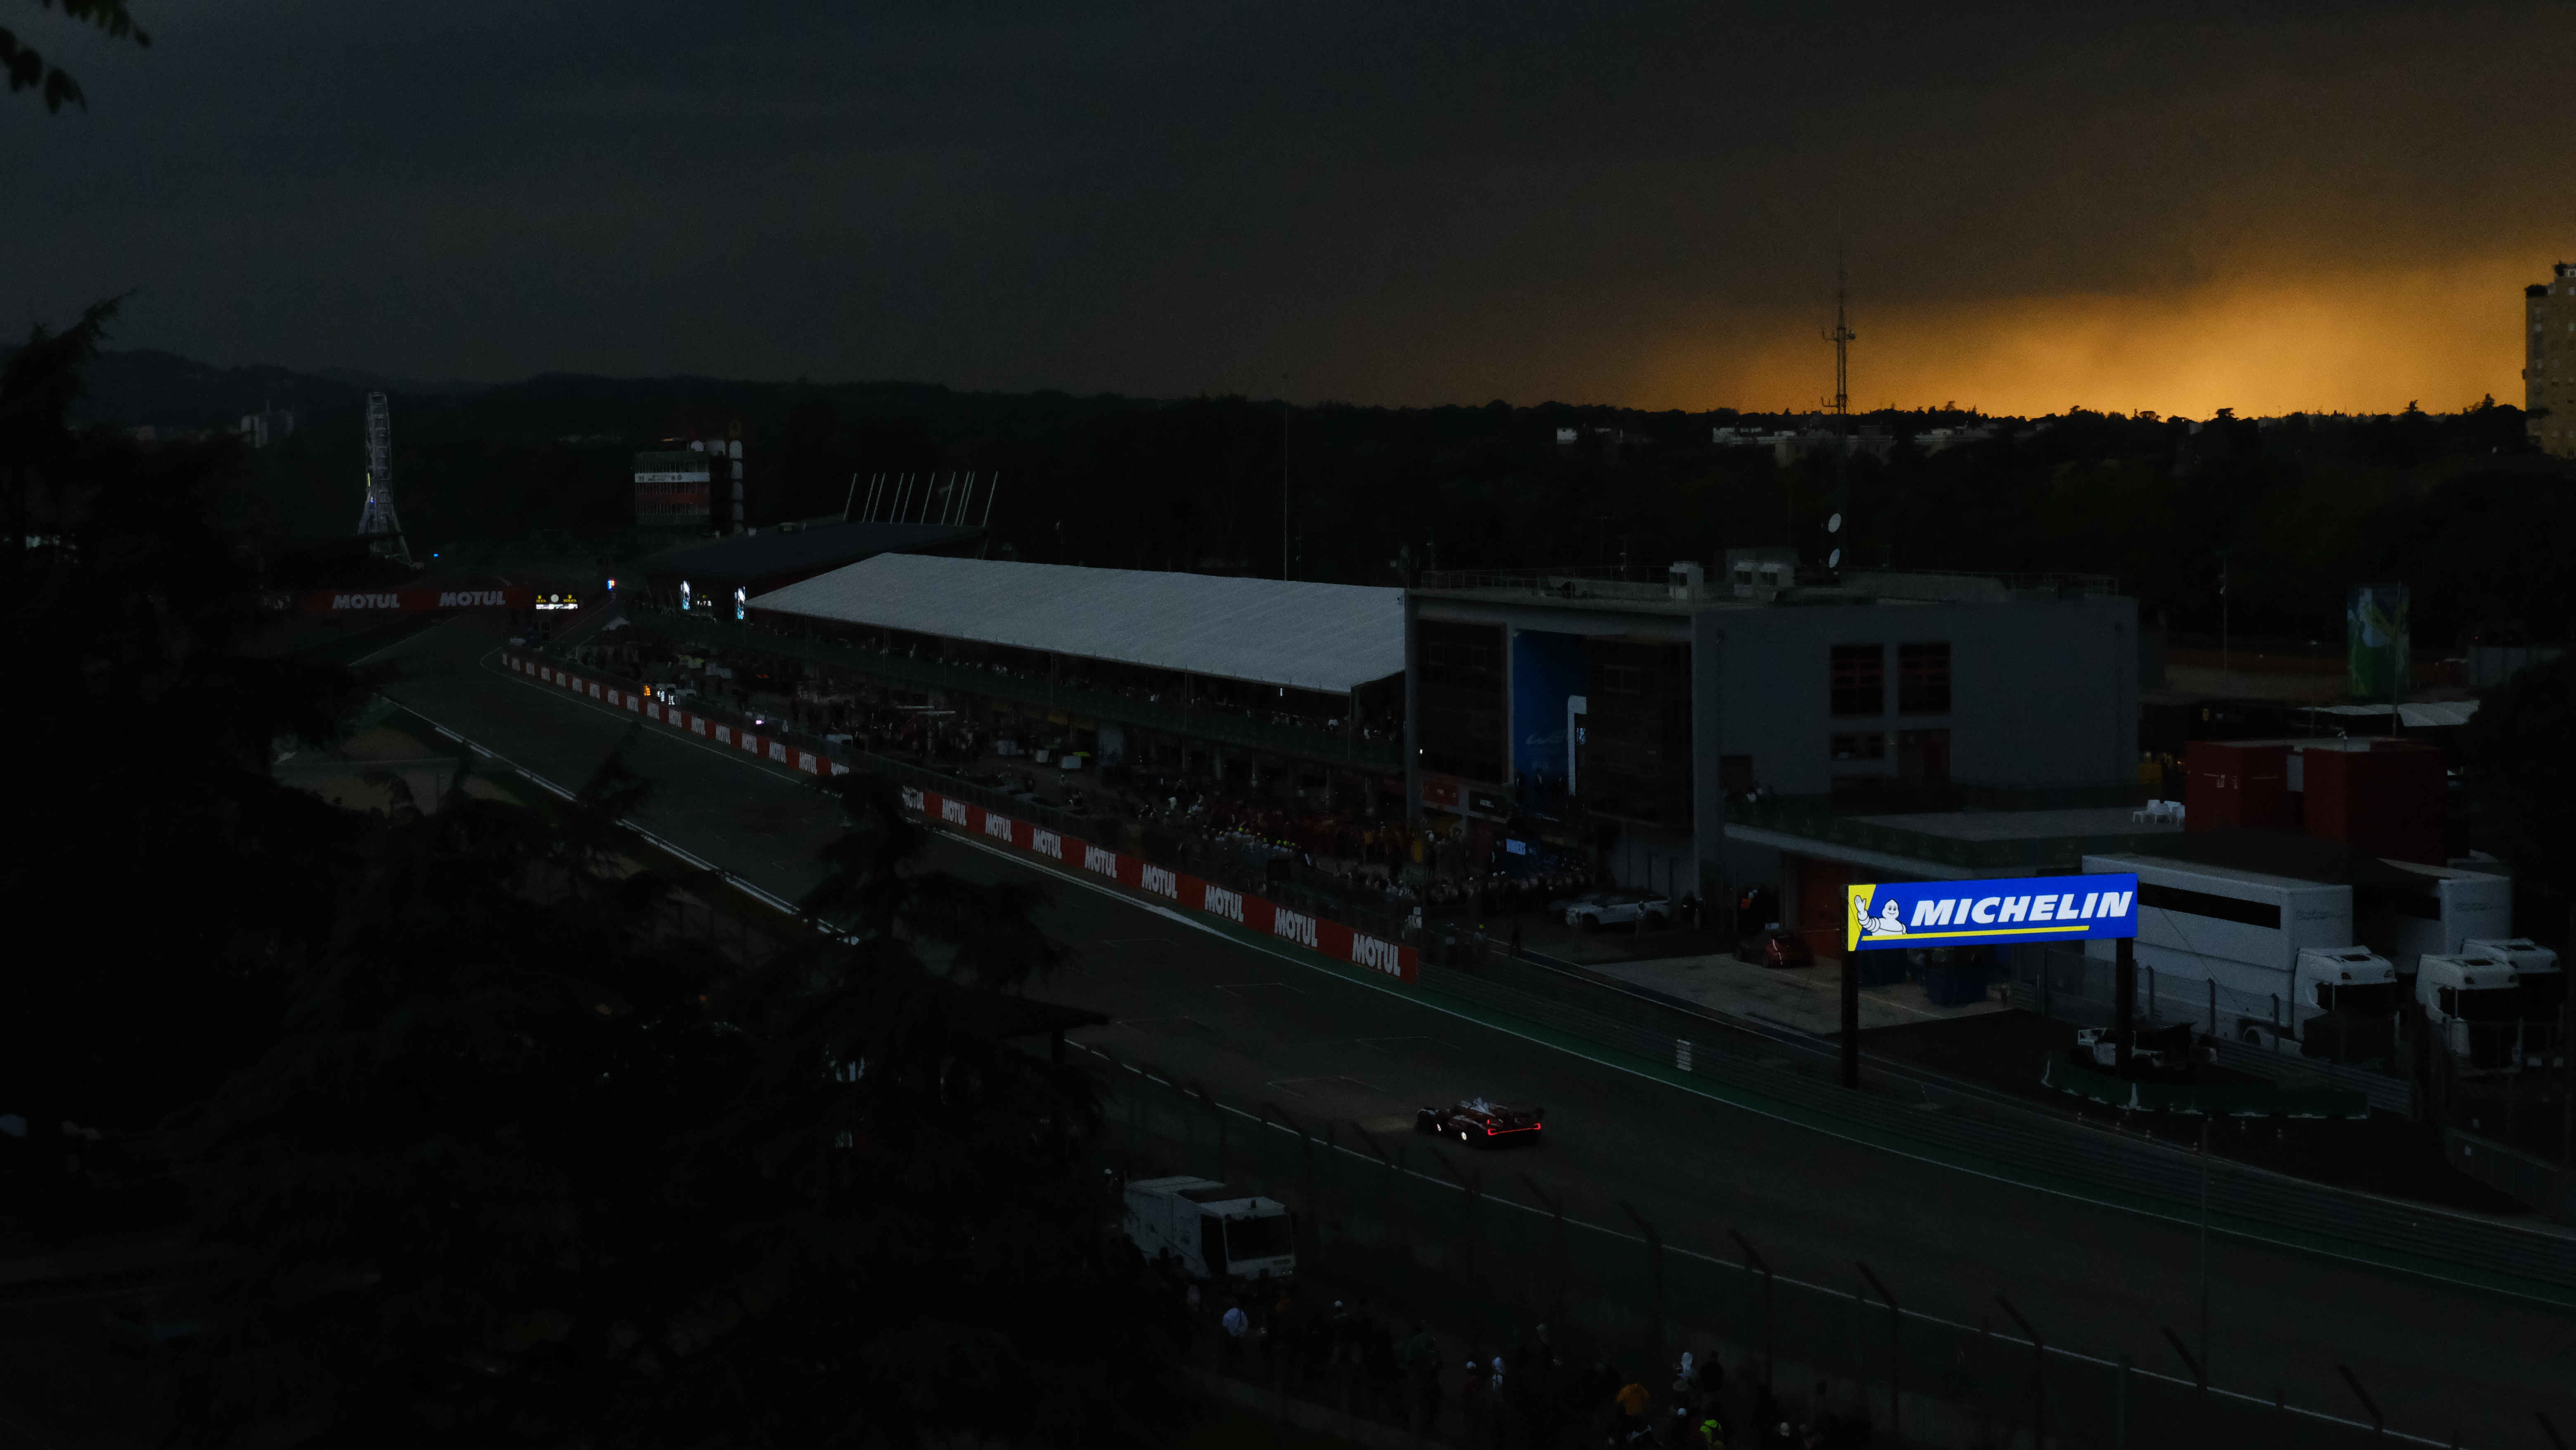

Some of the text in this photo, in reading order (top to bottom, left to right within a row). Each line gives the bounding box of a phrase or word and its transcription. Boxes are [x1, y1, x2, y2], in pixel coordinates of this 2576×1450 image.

[332, 594, 400, 609] MOTUL
[439, 591, 506, 607] MOTUL
[942, 798, 967, 826] MOTUL
[985, 813, 1012, 842] MOTUL
[1032, 828, 1062, 859] MOTUL
[1084, 845, 1117, 878] MOTUL
[1141, 864, 1177, 899] MOTUL
[1205, 884, 1244, 922] MOTUL
[1910, 891, 2133, 926] MICHELIN
[1274, 907, 1318, 948] MOTUL
[1352, 933, 1401, 976] MOTUL
